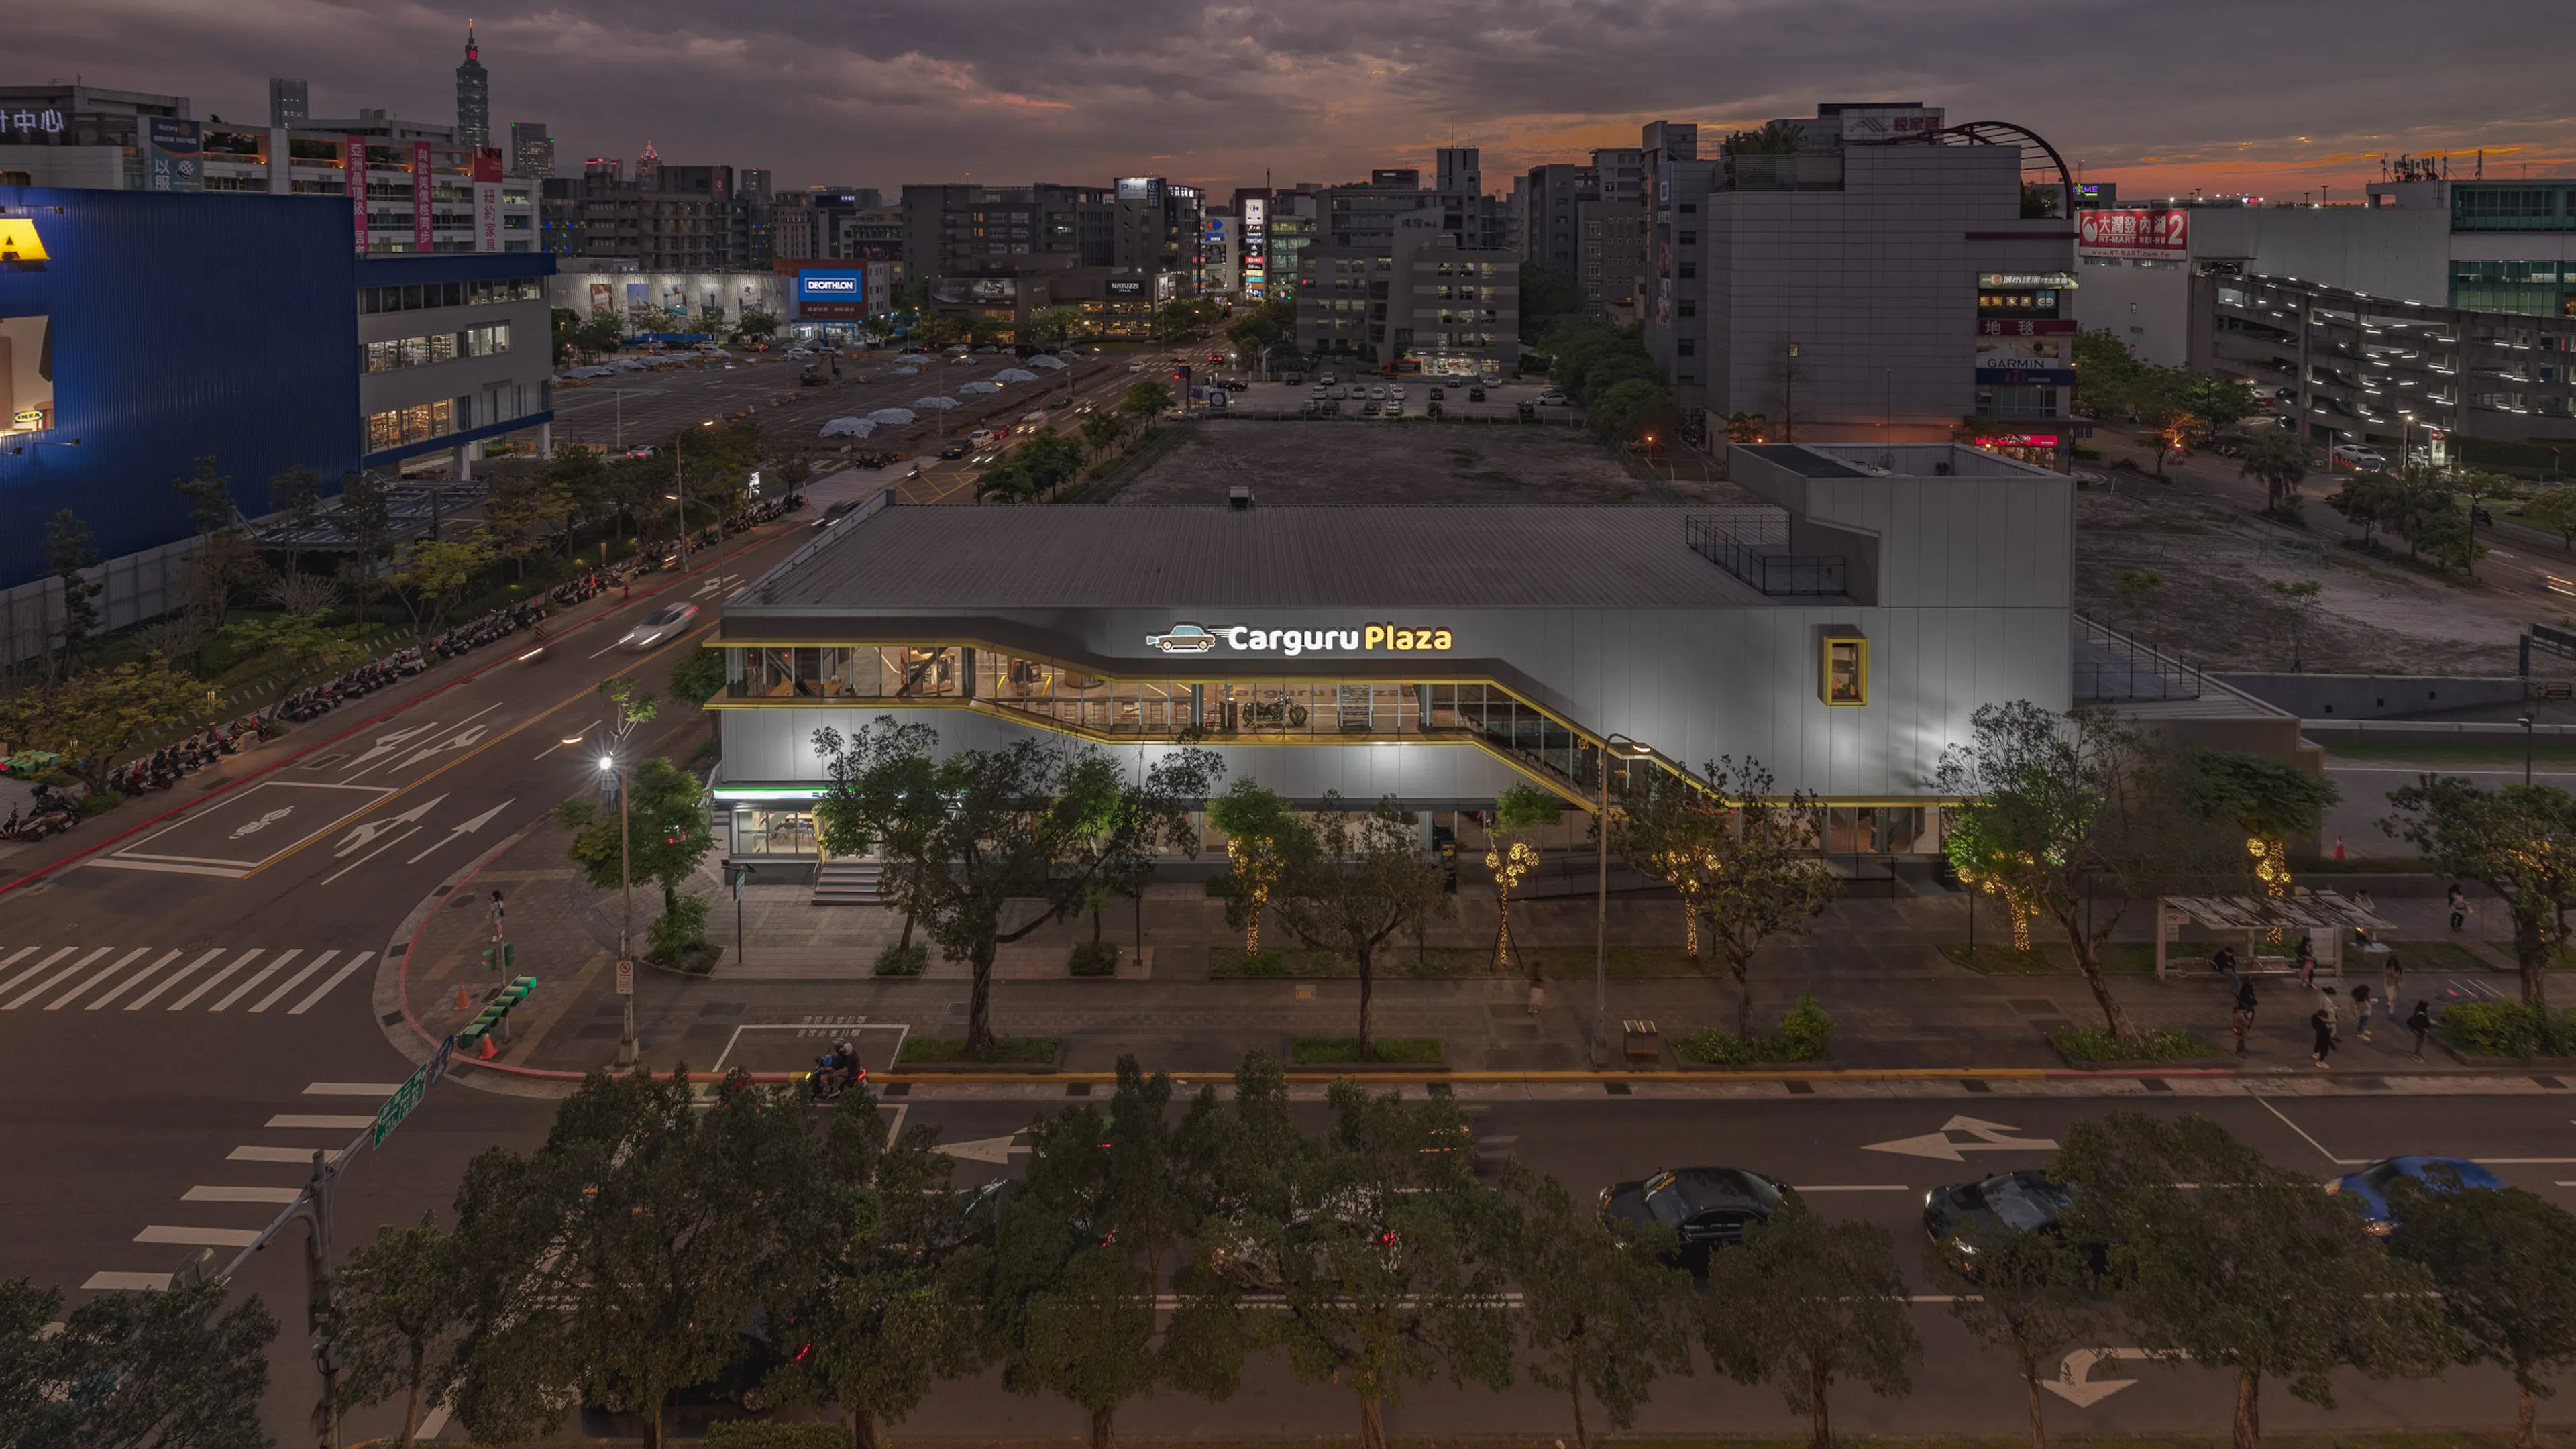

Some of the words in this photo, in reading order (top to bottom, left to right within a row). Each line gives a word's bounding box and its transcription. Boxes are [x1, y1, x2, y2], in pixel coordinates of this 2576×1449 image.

[417, 149, 431, 244] 與歐美價格同步
[2098, 215, 2136, 234] 大潤發
[2168, 215, 2184, 245] 2
[2139, 236, 2166, 245] NEI-HU
[2092, 248, 2171, 258] www.RT-MART.com.tw
[808, 281, 853, 290] DECATHLON
[1985, 320, 2034, 335] 地毯
[1988, 359, 2044, 368] GARMIN
[1228, 626, 1358, 656] Carguru
[1366, 625, 1452, 650] Plaza
